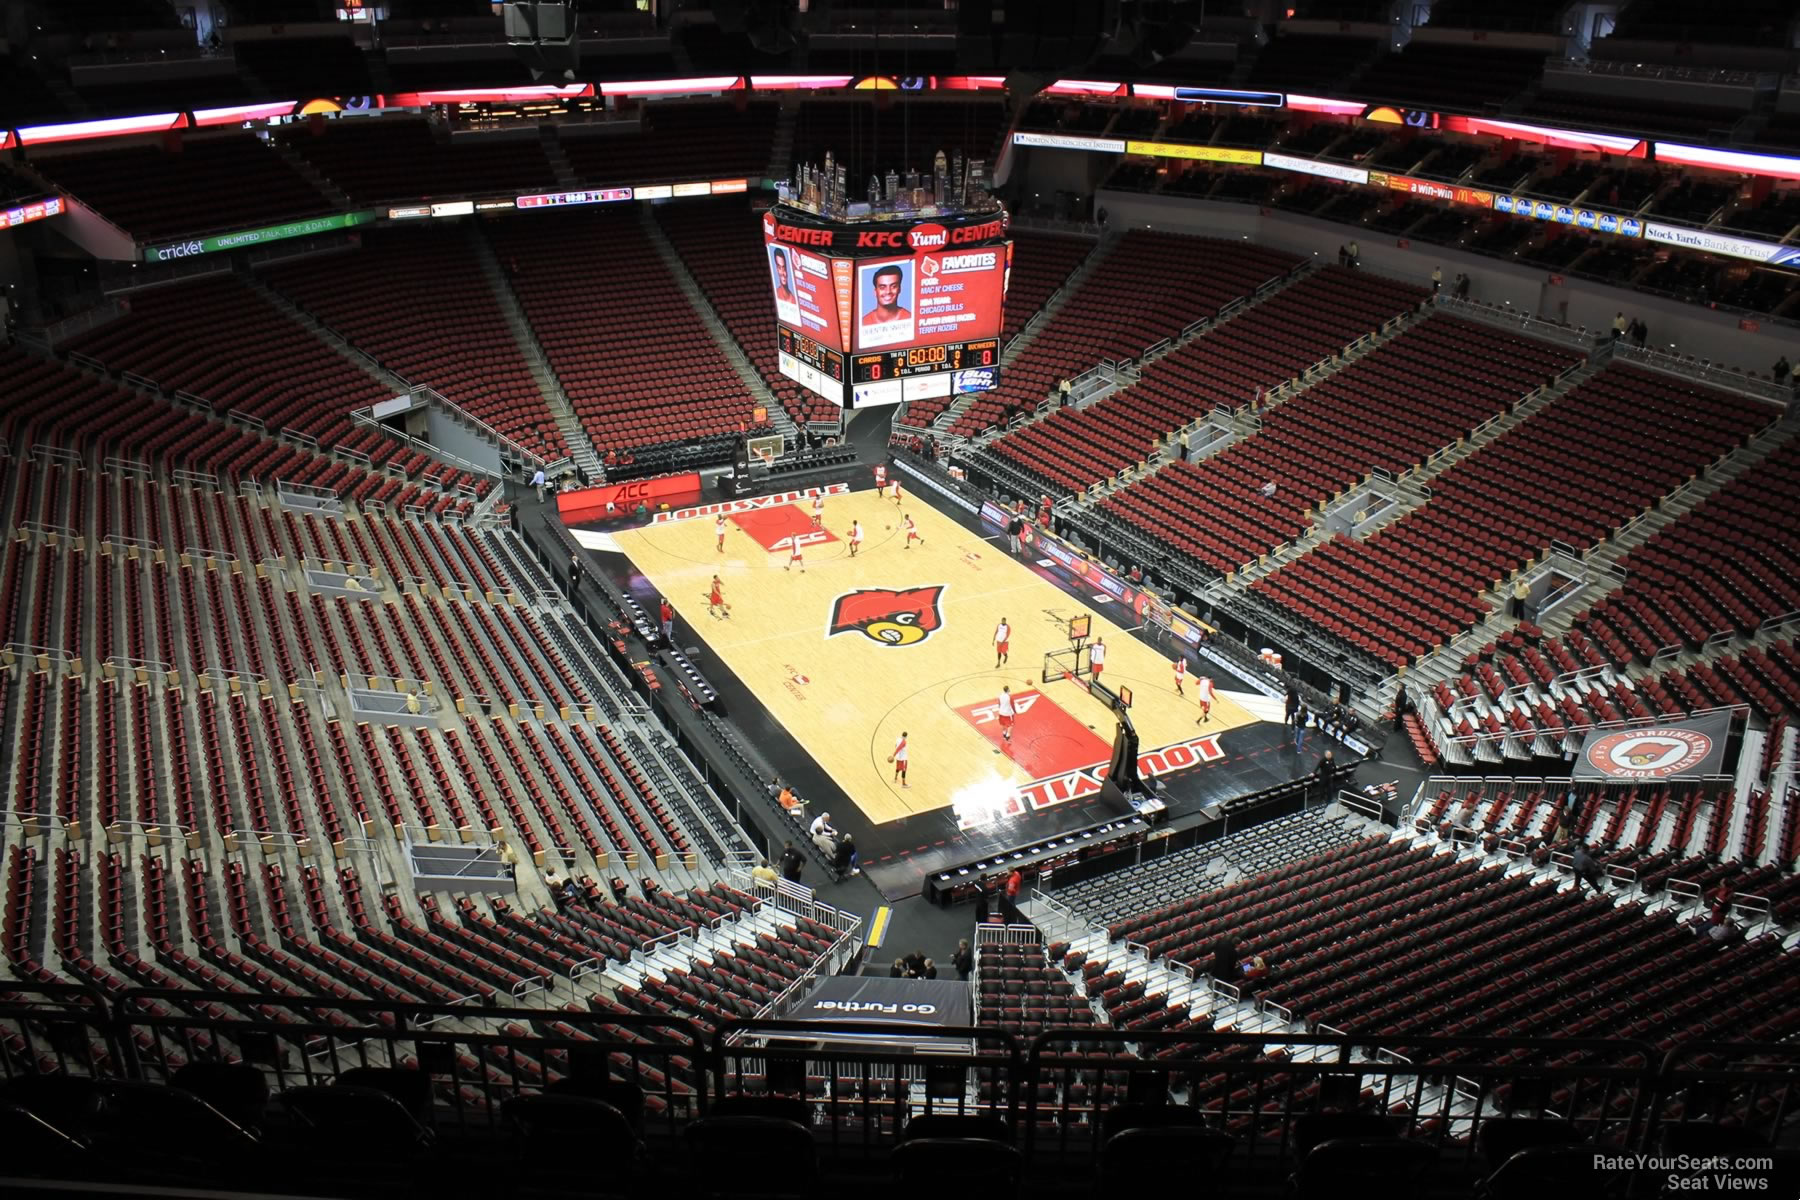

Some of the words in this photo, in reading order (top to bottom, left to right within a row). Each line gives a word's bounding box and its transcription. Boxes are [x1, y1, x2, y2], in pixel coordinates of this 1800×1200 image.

[1094, 140, 1123, 150] INSTITUTE
[1411, 183, 1416, 192] a
[1418, 183, 1454, 199] win-win
[158, 240, 204, 261] cricket
[217, 233, 260, 247] UNLIMITED
[311, 220, 332, 230] DATA
[777, 224, 833, 246] CENTER
[856, 231, 902, 247] KFC
[910, 230, 947, 247] Yum!
[952, 220, 1002, 243] CENTER
[1648, 228, 1674, 240] Stock
[1676, 233, 1702, 246] Yards
[1704, 239, 1728, 251] Bank
[1742, 245, 1770, 258] Trust
[942, 253, 996, 270] FAVORITES
[921, 285, 937, 294] MAC
[943, 284, 964, 292] CHEESE
[920, 305, 944, 314] CHICAGO
[945, 304, 964, 312] BULLS
[919, 325, 936, 334] TERRY
[858, 356, 882, 364] CARDS
[909, 347, 945, 364] 60:00
[872, 364, 880, 379] 0
[898, 358, 903, 367] 0
[955, 350, 960, 359] 0
[983, 350, 991, 364] 0
[958, 377, 992, 387] LIGHT
[962, 369, 992, 378] BUD
[614, 483, 648, 501] ACC
[652, 482, 850, 526] LOUISVILLE
[768, 531, 827, 550] ACC
[1624, 730, 1700, 742] CARDINAL
[1664, 738, 1706, 774] ATHLETIC
[814, 1000, 898, 1014] Further
[902, 1003, 936, 1014] Go
